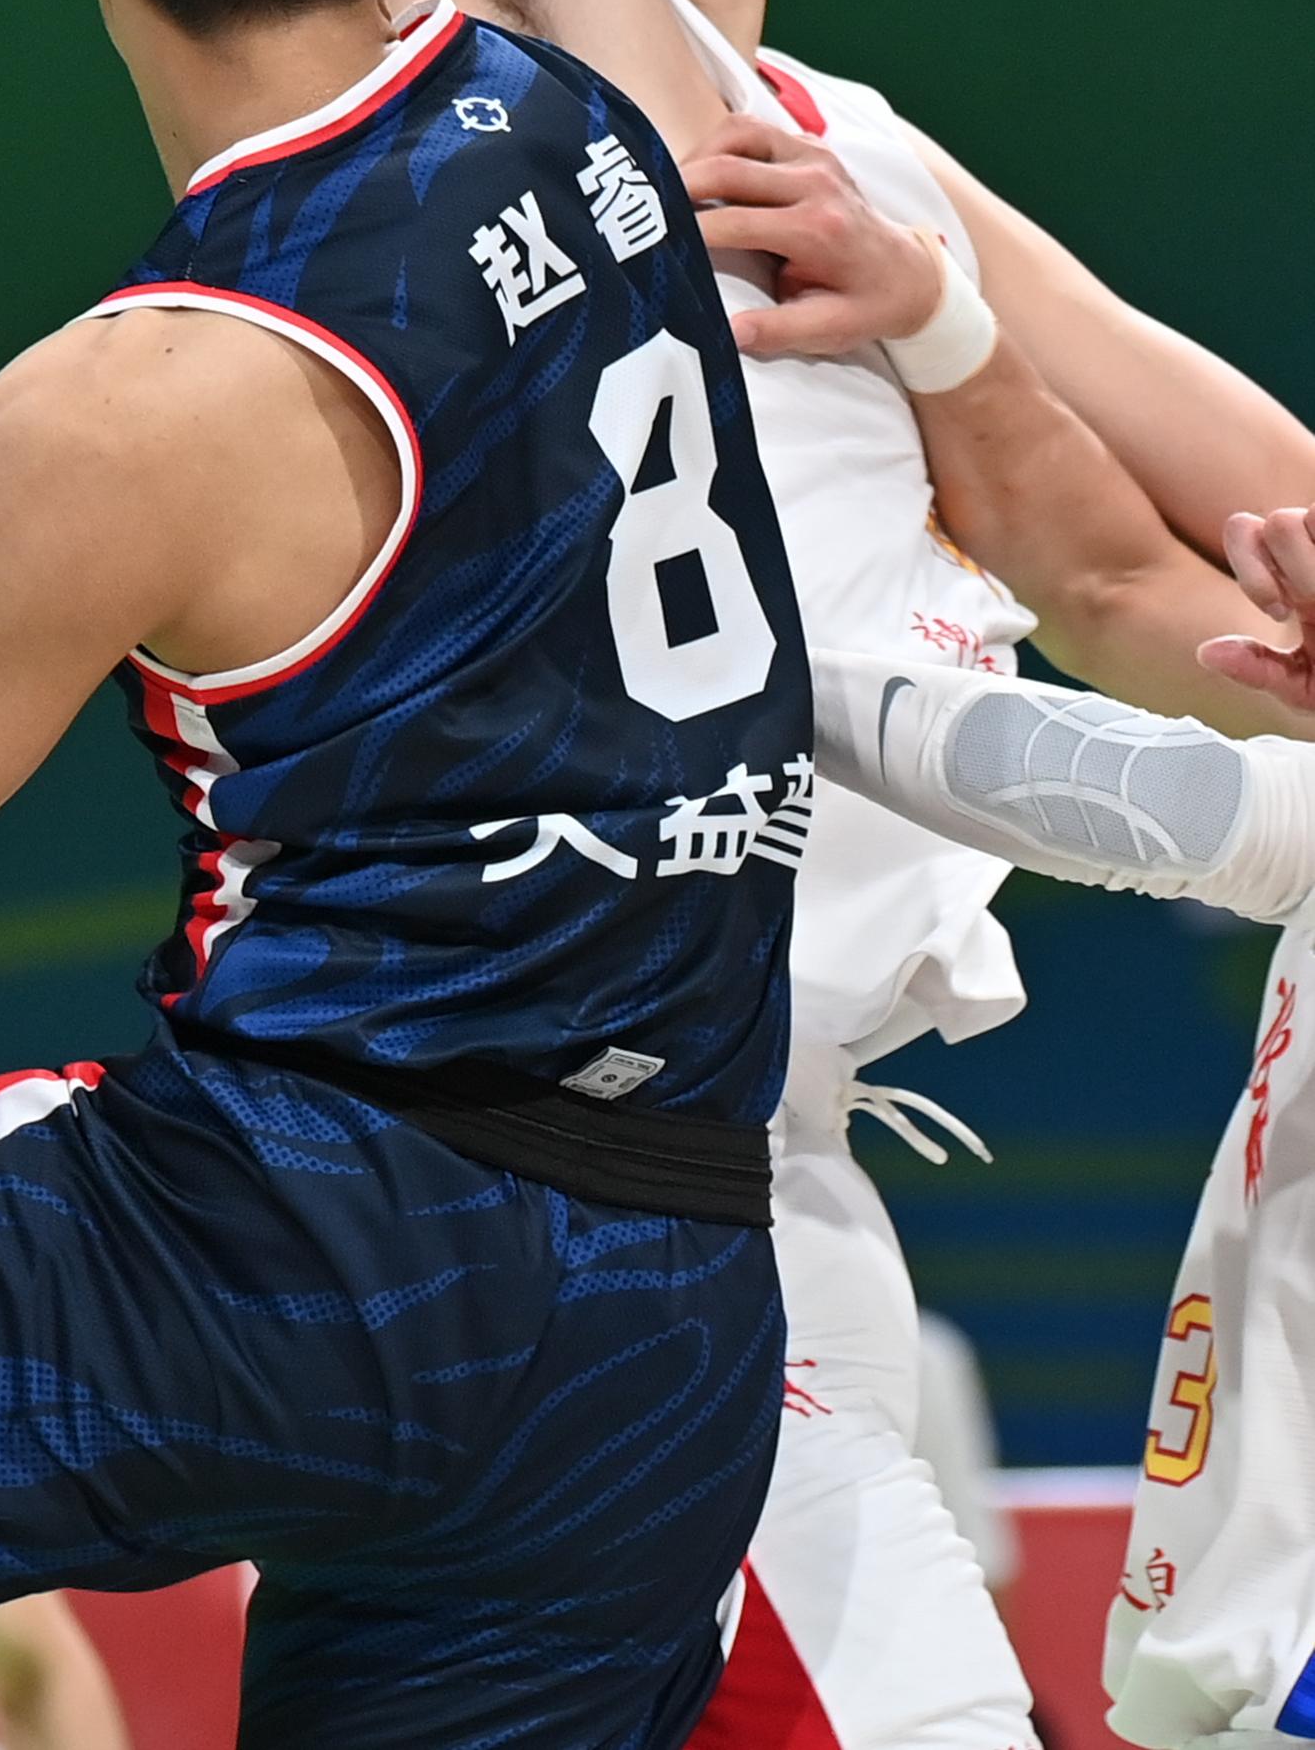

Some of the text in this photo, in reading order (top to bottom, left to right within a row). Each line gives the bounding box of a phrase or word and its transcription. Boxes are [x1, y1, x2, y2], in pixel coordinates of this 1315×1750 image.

[468, 134, 668, 347] 赵睿
[588, 327, 778, 723] 8
[1144, 1292, 1219, 1488] 3
